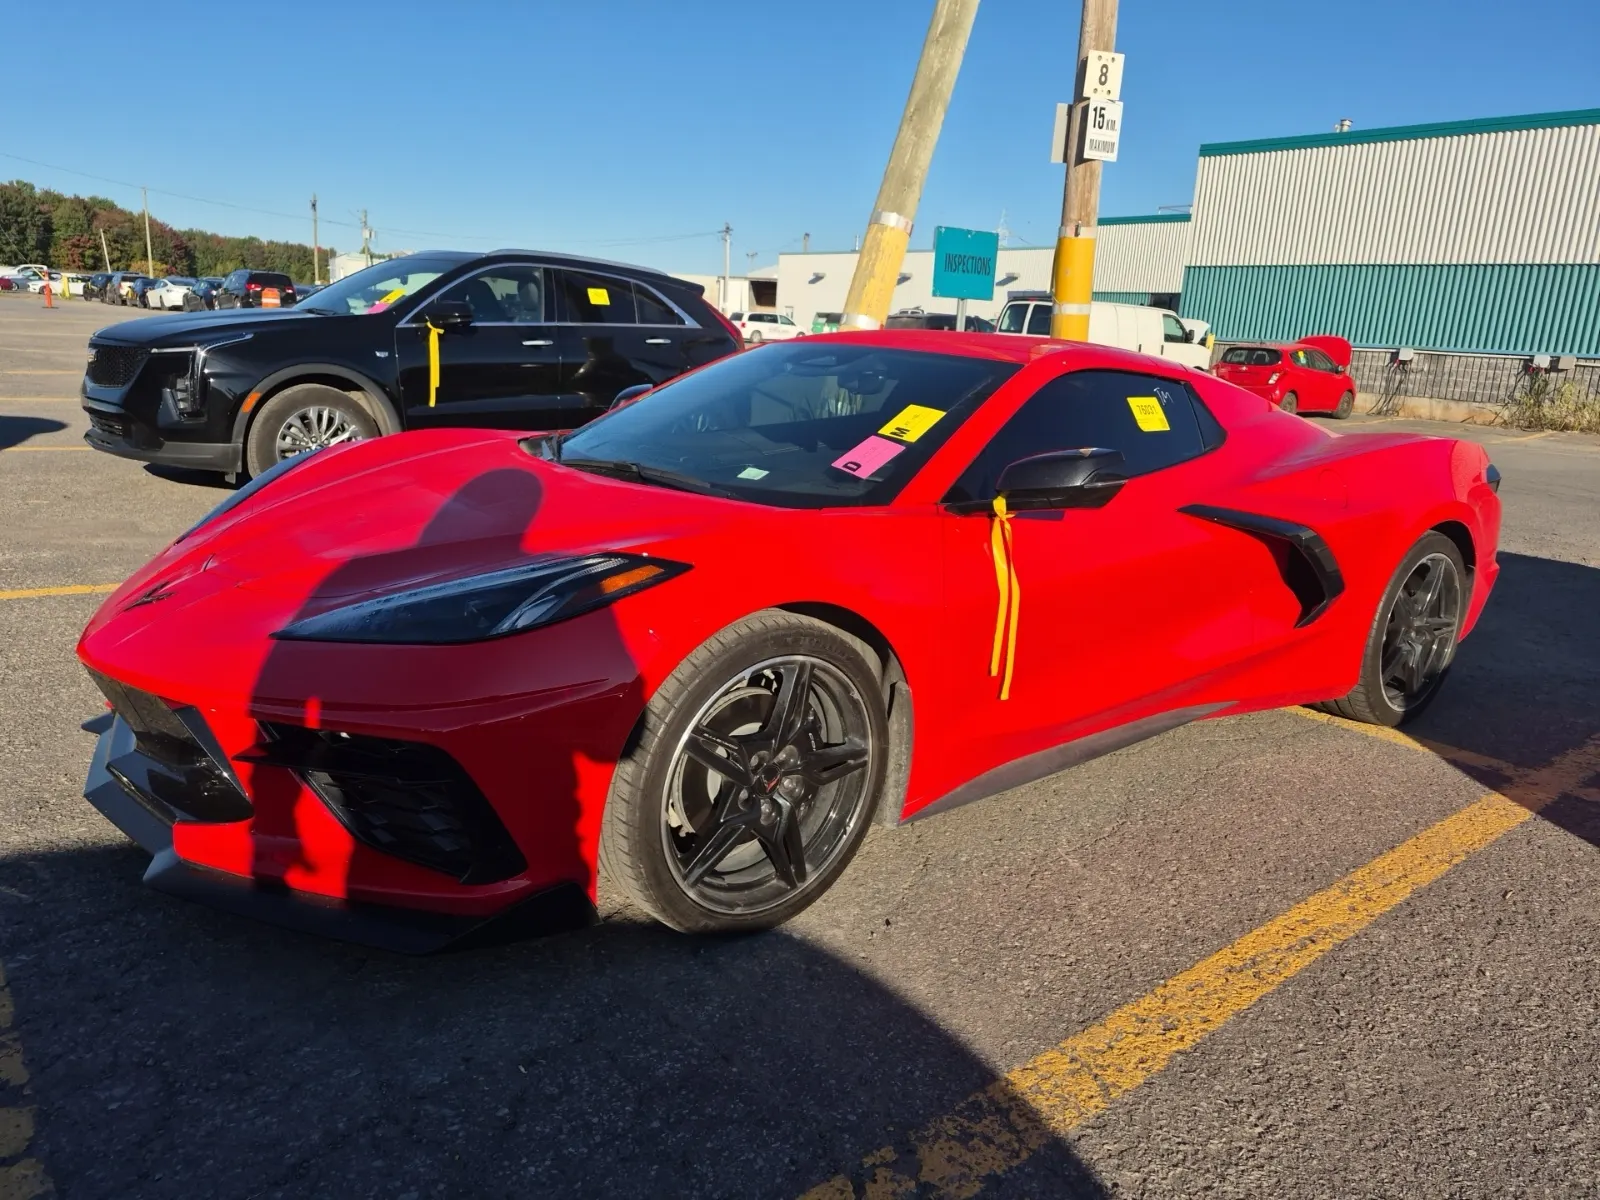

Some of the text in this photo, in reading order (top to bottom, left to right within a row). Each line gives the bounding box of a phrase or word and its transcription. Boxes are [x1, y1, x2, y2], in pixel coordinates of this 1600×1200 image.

[1098, 63, 1109, 86] 8
[1092, 105, 1107, 130] 15
[1088, 138, 1116, 154] MAXIMUM
[943, 253, 992, 277] INSPECTIONS
[889, 426, 911, 438] M
[842, 461, 862, 473] D
